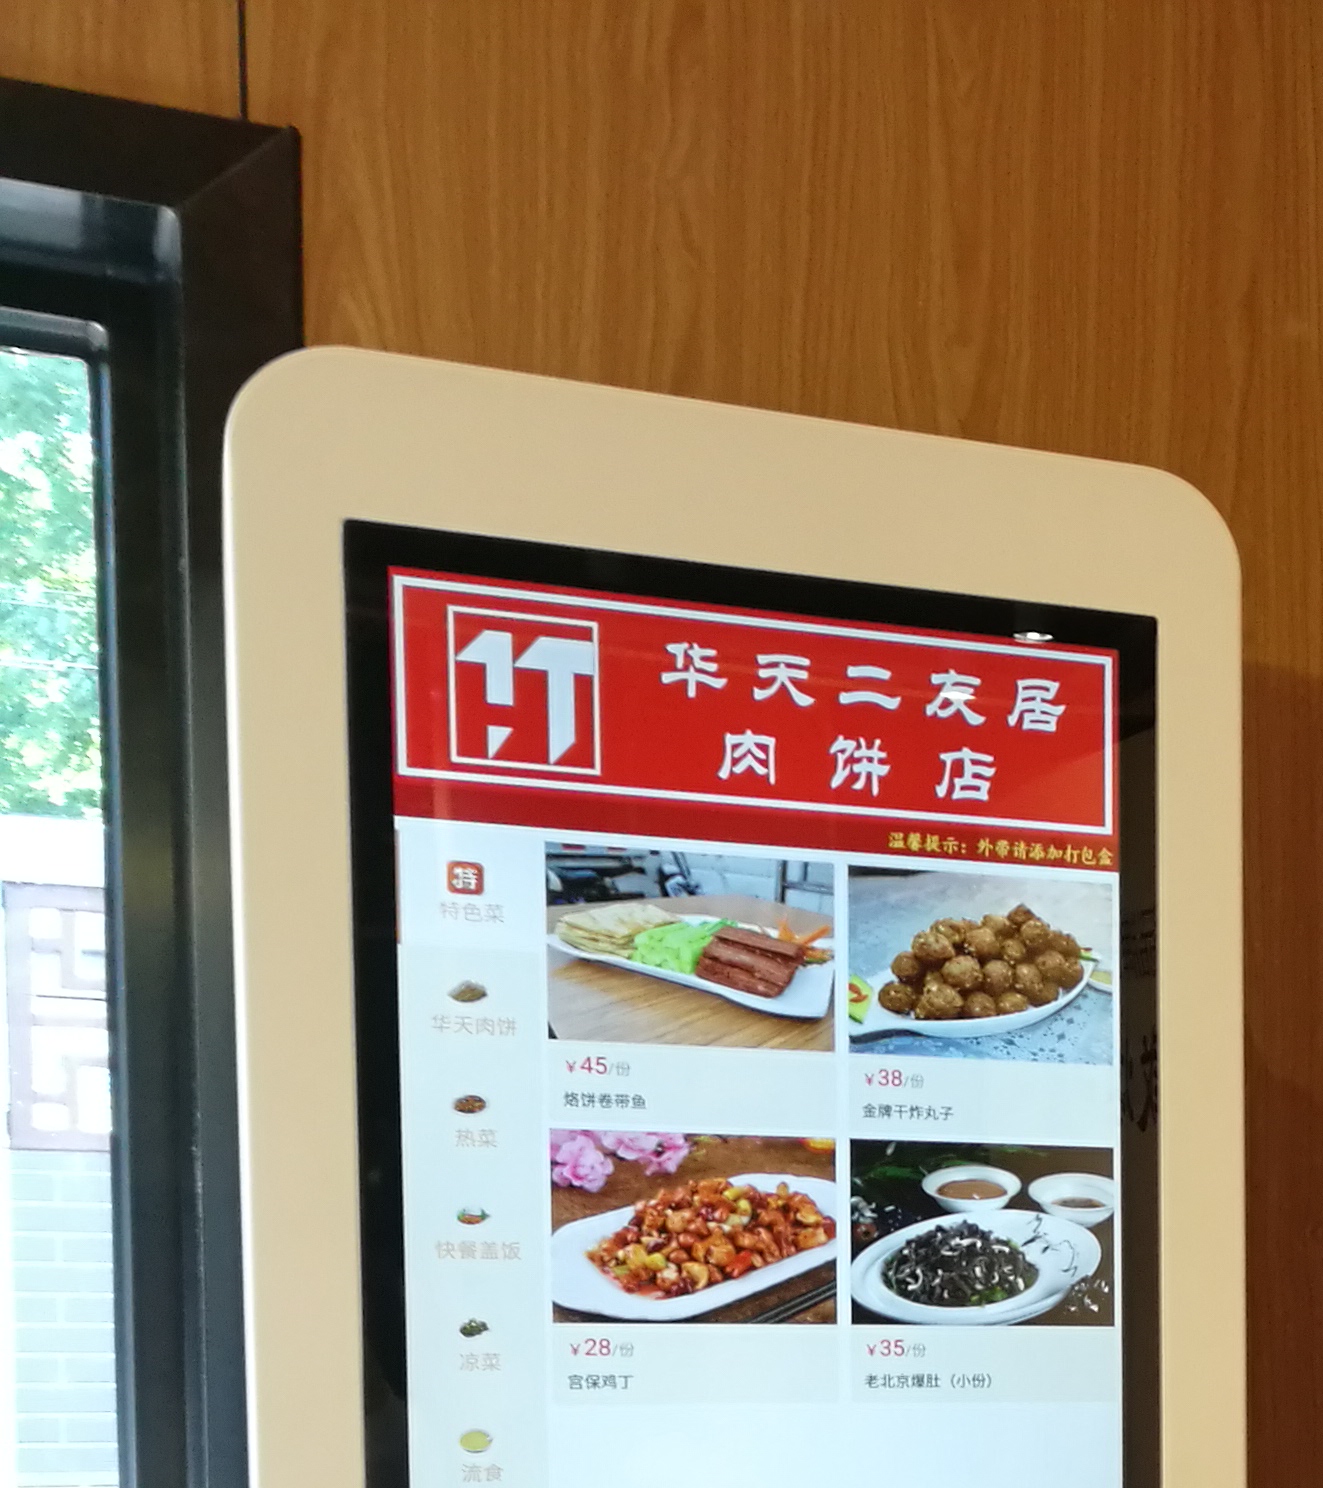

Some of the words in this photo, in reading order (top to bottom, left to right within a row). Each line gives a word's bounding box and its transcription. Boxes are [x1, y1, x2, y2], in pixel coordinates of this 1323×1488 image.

[659, 640, 1066, 733] 华天二友居
[717, 729, 997, 803] 肉饼店
[440, 901, 505, 923] 特色菜
[431, 1014, 518, 1037] 华天肉饼
[563, 1091, 647, 1111] 烙饼卷带鱼
[862, 1103, 954, 1121] 金牌干炸丸子
[455, 1129, 497, 1149] 热菜
[435, 1241, 522, 1261] 快餐盖饭
[459, 1353, 502, 1372] 凉菜
[567, 1373, 634, 1391] 宫保鸡丁
[461, 1463, 504, 1483] 流食
